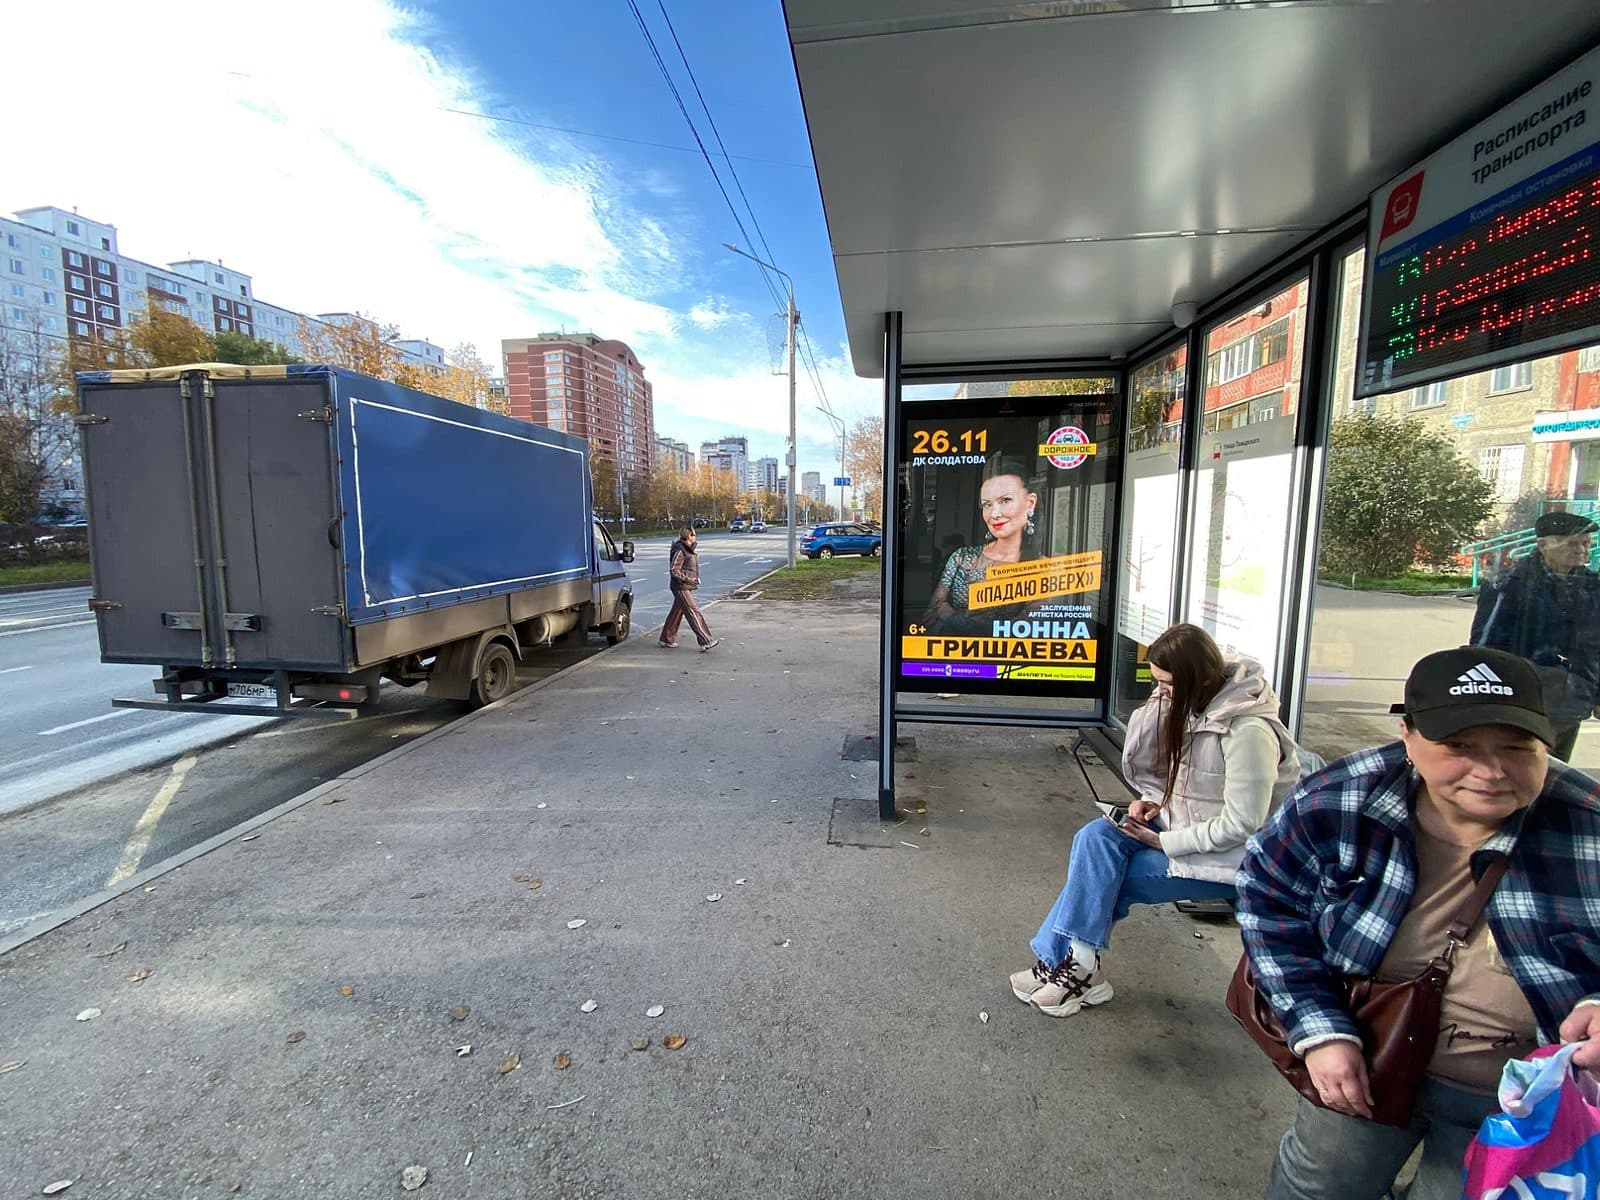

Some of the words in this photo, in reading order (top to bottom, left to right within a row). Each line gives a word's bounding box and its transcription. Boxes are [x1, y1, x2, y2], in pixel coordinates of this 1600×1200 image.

[1473, 79, 1592, 162] Расписание
[1471, 109, 1586, 184] транспорта
[1469, 190, 1523, 223] Конечная
[912, 429, 987, 454] 26.11
[1044, 445, 1091, 454] ДОРОЖНОЕ
[912, 456, 926, 467] ДК
[928, 455, 986, 466] СОЛДАТОВА
[976, 580, 1037, 603] «ПАДАЮ
[1040, 571, 1094, 594] ВВЕРХ»
[909, 623, 927, 636] 6+
[992, 620, 1091, 639] НОННА
[927, 640, 1089, 660] ГРИШАЕВА
[1448, 681, 1514, 696] adidas
